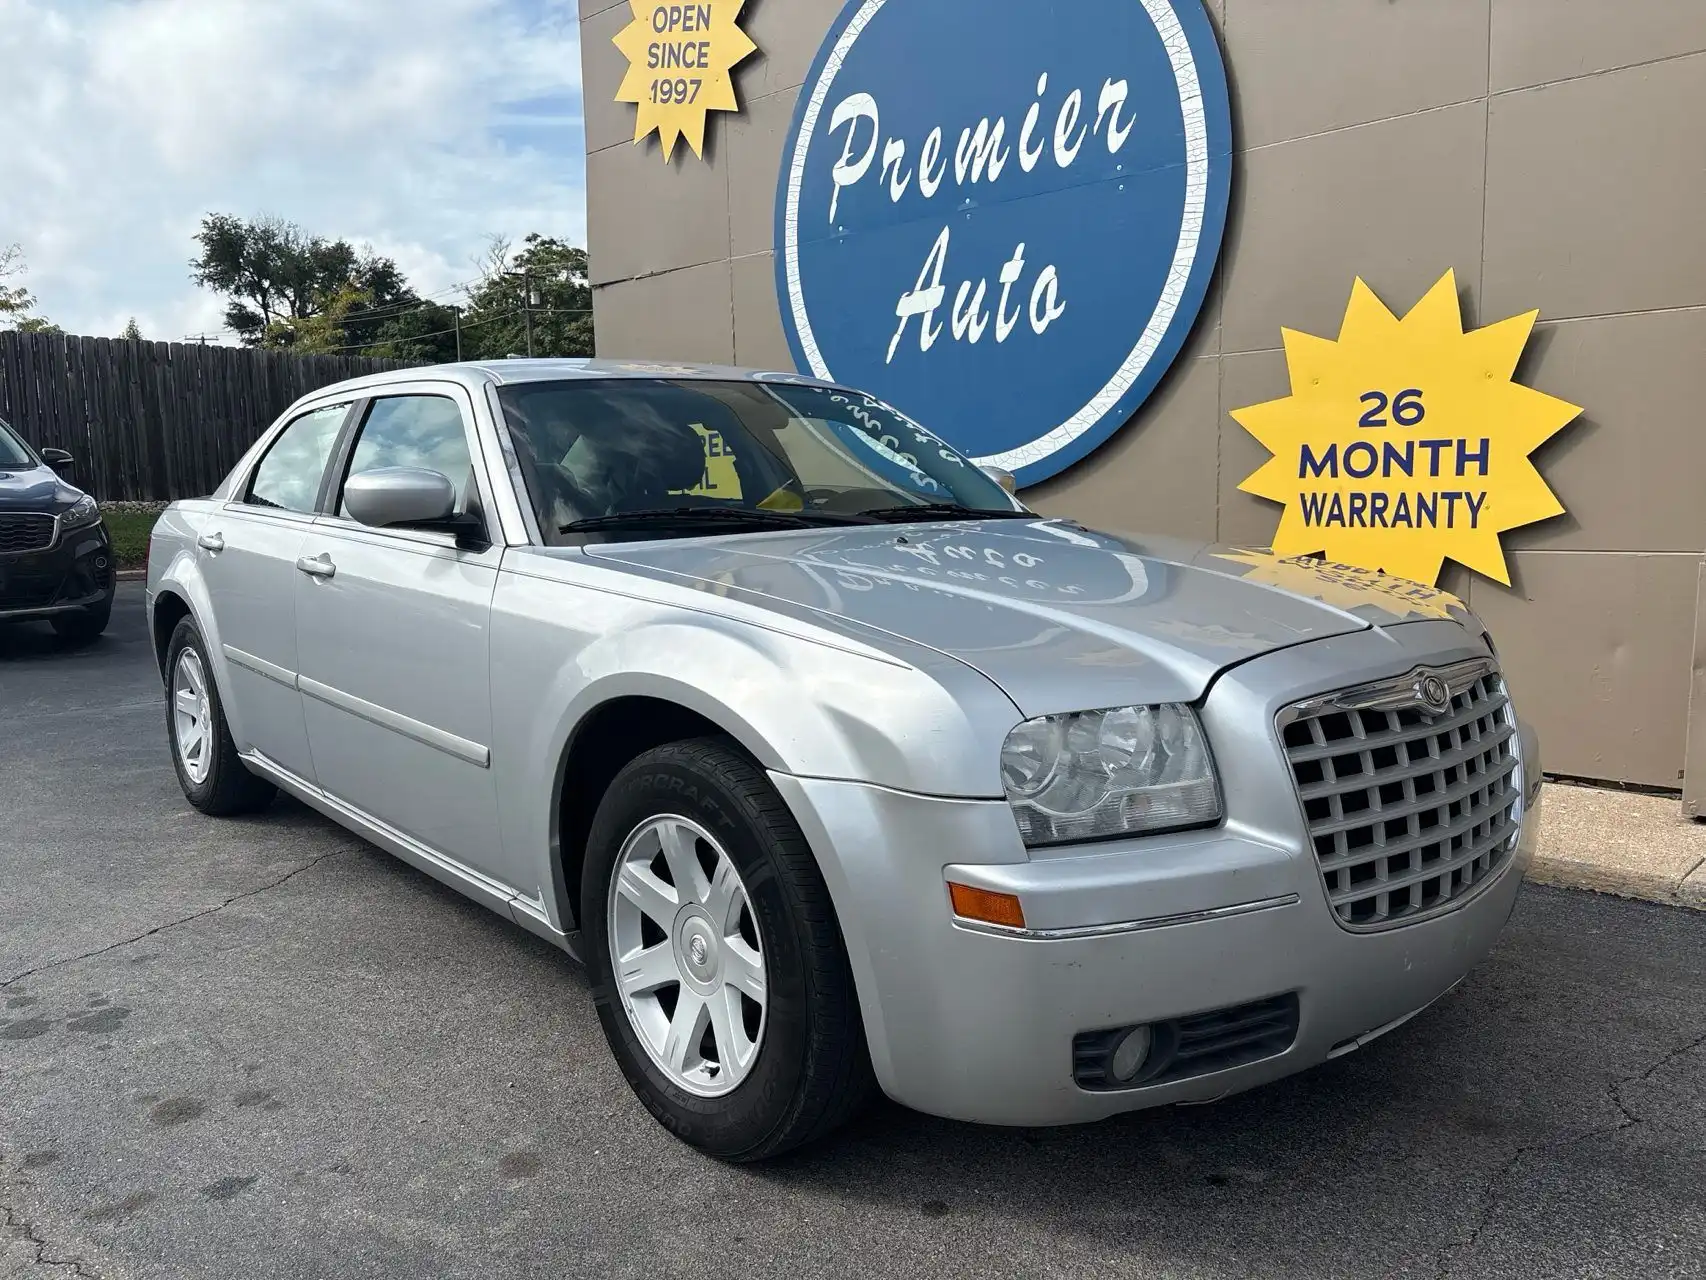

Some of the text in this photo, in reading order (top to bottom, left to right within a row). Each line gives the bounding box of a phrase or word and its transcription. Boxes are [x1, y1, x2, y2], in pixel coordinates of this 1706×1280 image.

[652, 4, 712, 33] OPEN
[647, 42, 710, 69] SINCE
[651, 79, 702, 104] 1997
[828, 72, 1136, 224] Premier
[886, 225, 1066, 364] Auto
[1358, 389, 1426, 428] 26
[1298, 438, 1491, 479] MONTH
[1300, 491, 1488, 529] WARRANTY
